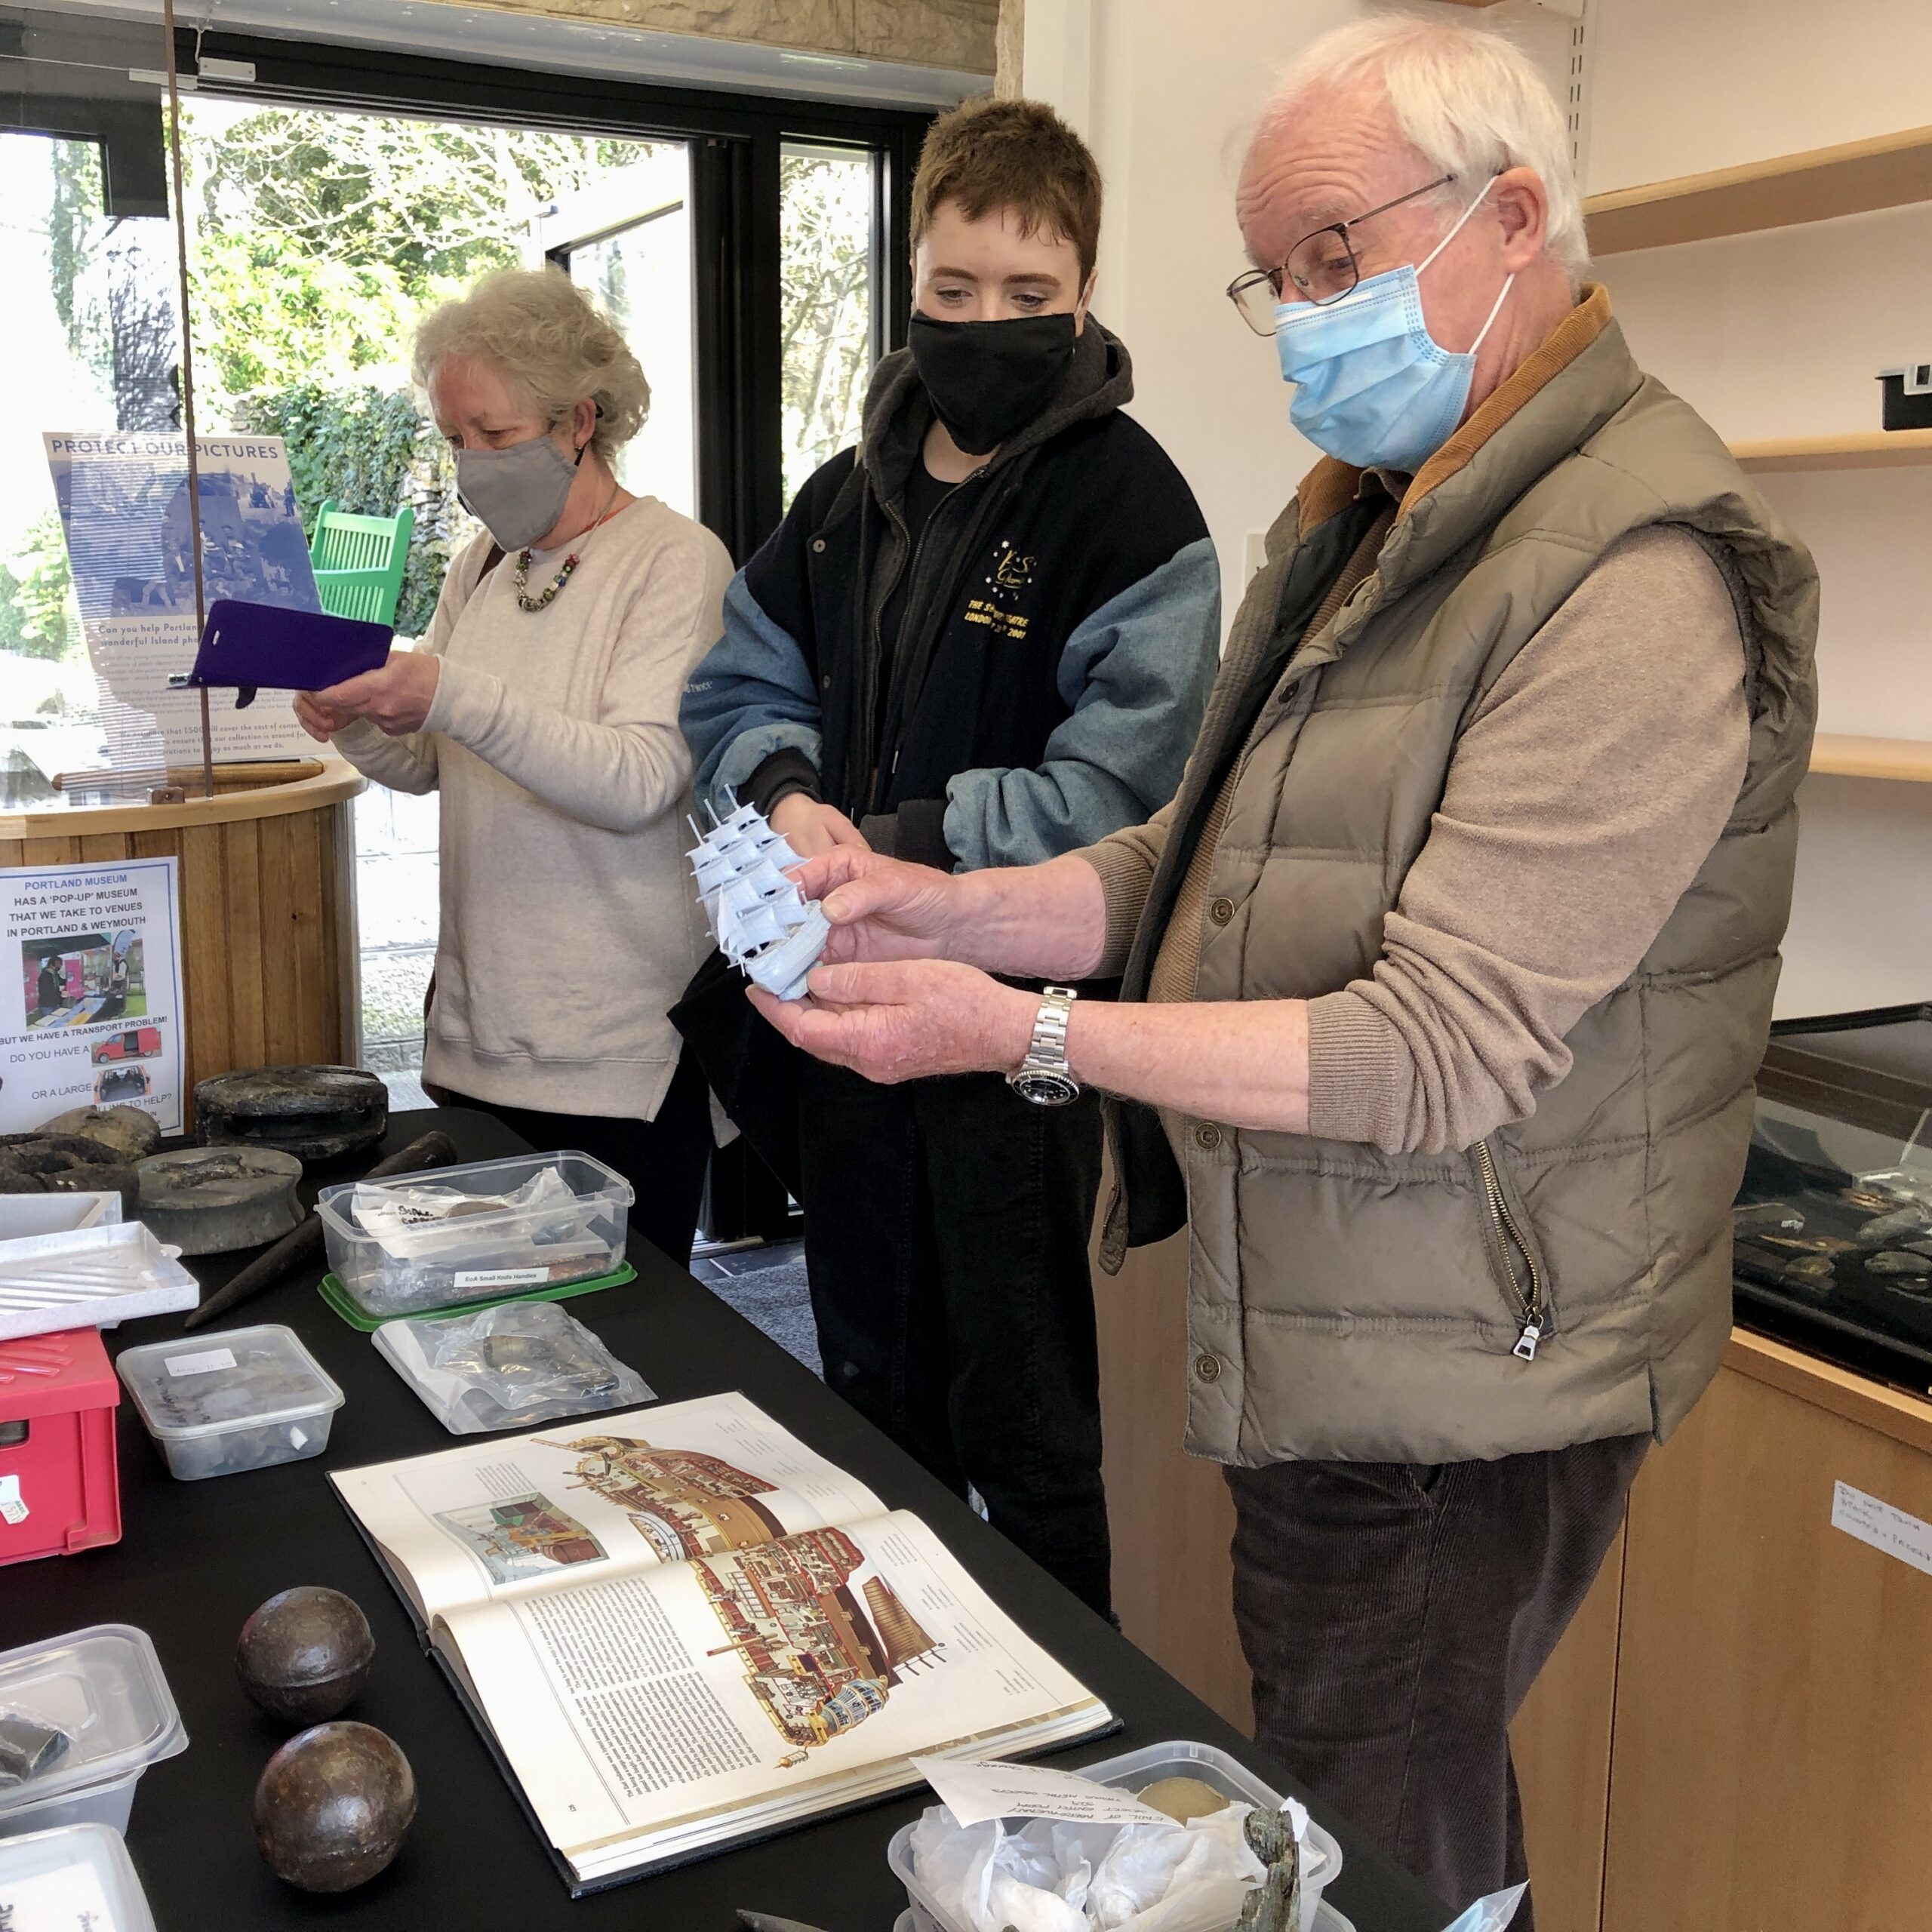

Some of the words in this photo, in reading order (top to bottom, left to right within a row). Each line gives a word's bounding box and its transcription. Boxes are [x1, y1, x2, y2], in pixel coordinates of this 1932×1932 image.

[146, 441, 187, 456] OUR
[195, 444, 278, 459] PICTURES
[98, 625, 117, 634] Can
[121, 626, 137, 635] you
[140, 624, 160, 635] help
[164, 623, 198, 632] Portlan
[100, 636, 148, 648] wonderful
[151, 635, 179, 645] Island
[270, 721, 277, 731] of
[271, 731, 295, 740] around
[25, 878, 82, 891] PORTLAND
[85, 875, 128, 887] MUSEUM
[14, 897, 37, 906] HAS
[39, 896, 48, 905] A
[96, 888, 137, 900] MUSEUM
[9, 912, 37, 922] THAT
[39, 910, 57, 920] WE
[60, 908, 87, 918] TAKE
[89, 906, 103, 915] TO
[105, 902, 143, 914] VENUES
[7, 929, 18, 937] IN
[20, 923, 78, 937] PORTLAND
[81, 922, 88, 931] &
[91, 915, 146, 930] WEYMOUTH
[19, 1035, 34, 1043] WE
[36, 1031, 60, 1041] HAVE
[71, 1023, 122, 1037] TRANSPORT
[125, 1016, 168, 1029] PROBLEM!
[10, 1054, 26, 1063] DO
[28, 1051, 51, 1061] YOU
[54, 1046, 81, 1058] HAVE
[83, 1045, 90, 1054] A
[32, 1091, 48, 1100] OR
[49, 1089, 57, 1097] A
[58, 1083, 92, 1095] LARGE
[143, 1093, 172, 1106] HELP?
